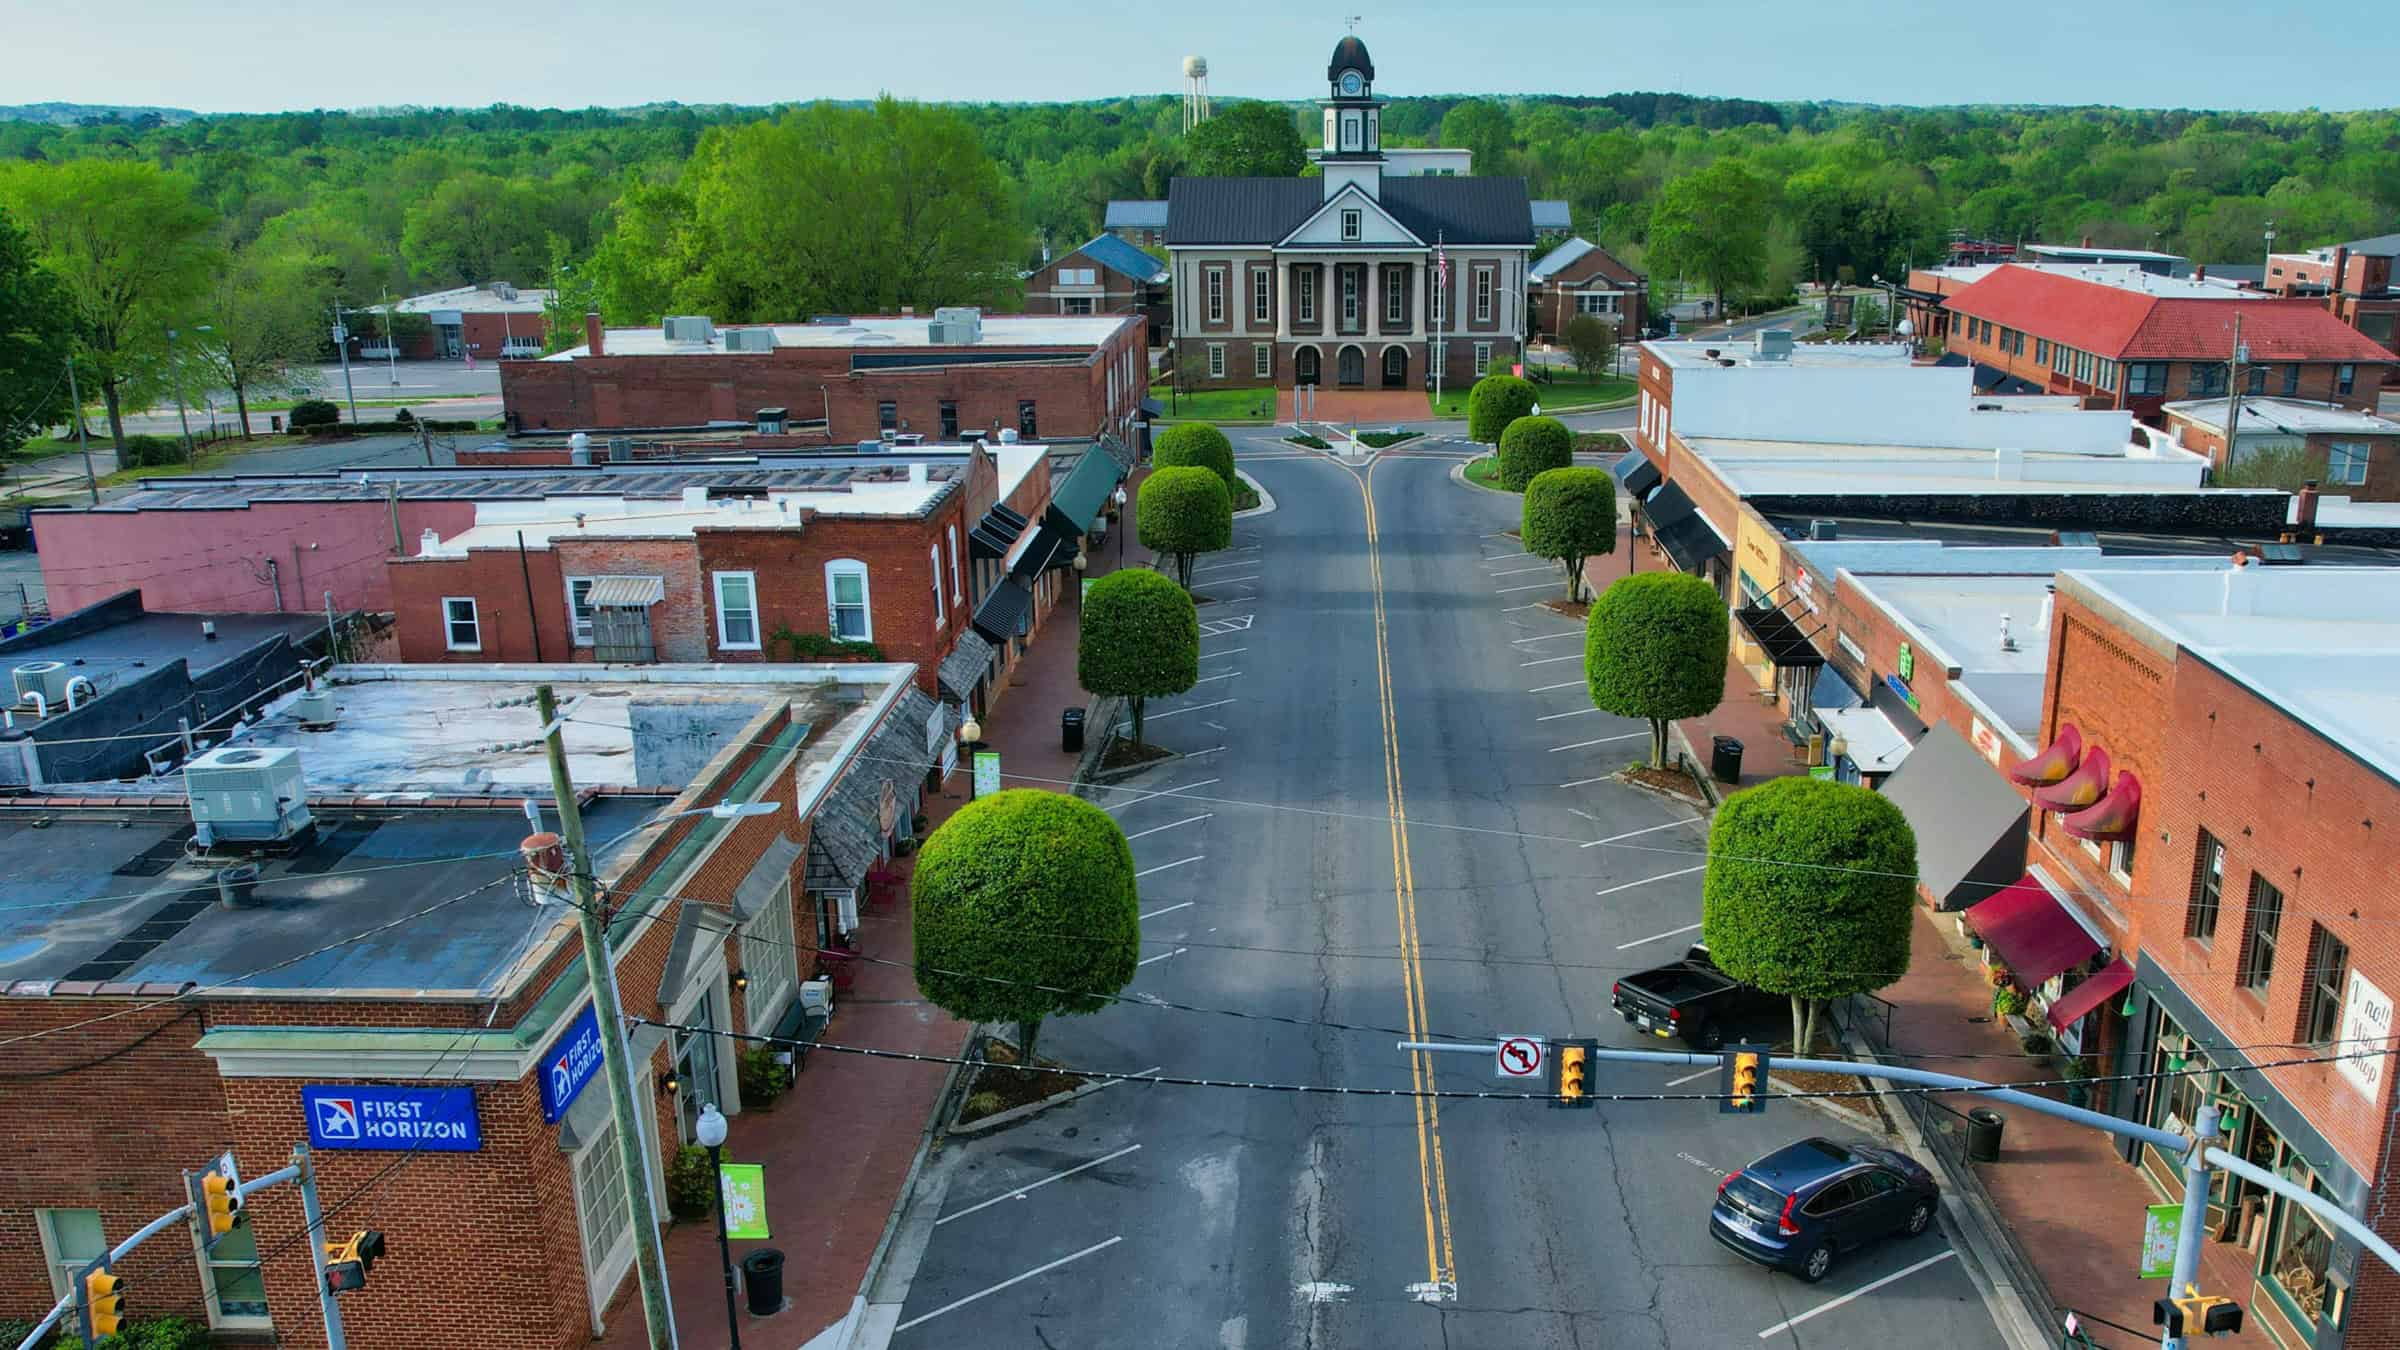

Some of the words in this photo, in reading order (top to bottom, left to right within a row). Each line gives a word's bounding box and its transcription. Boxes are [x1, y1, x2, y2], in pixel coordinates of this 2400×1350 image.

[568, 1027, 591, 1066] FIRST
[571, 1038, 602, 1085] HORIZO
[362, 1101, 422, 1118] FIRST
[365, 1121, 467, 1139] HORIZON
